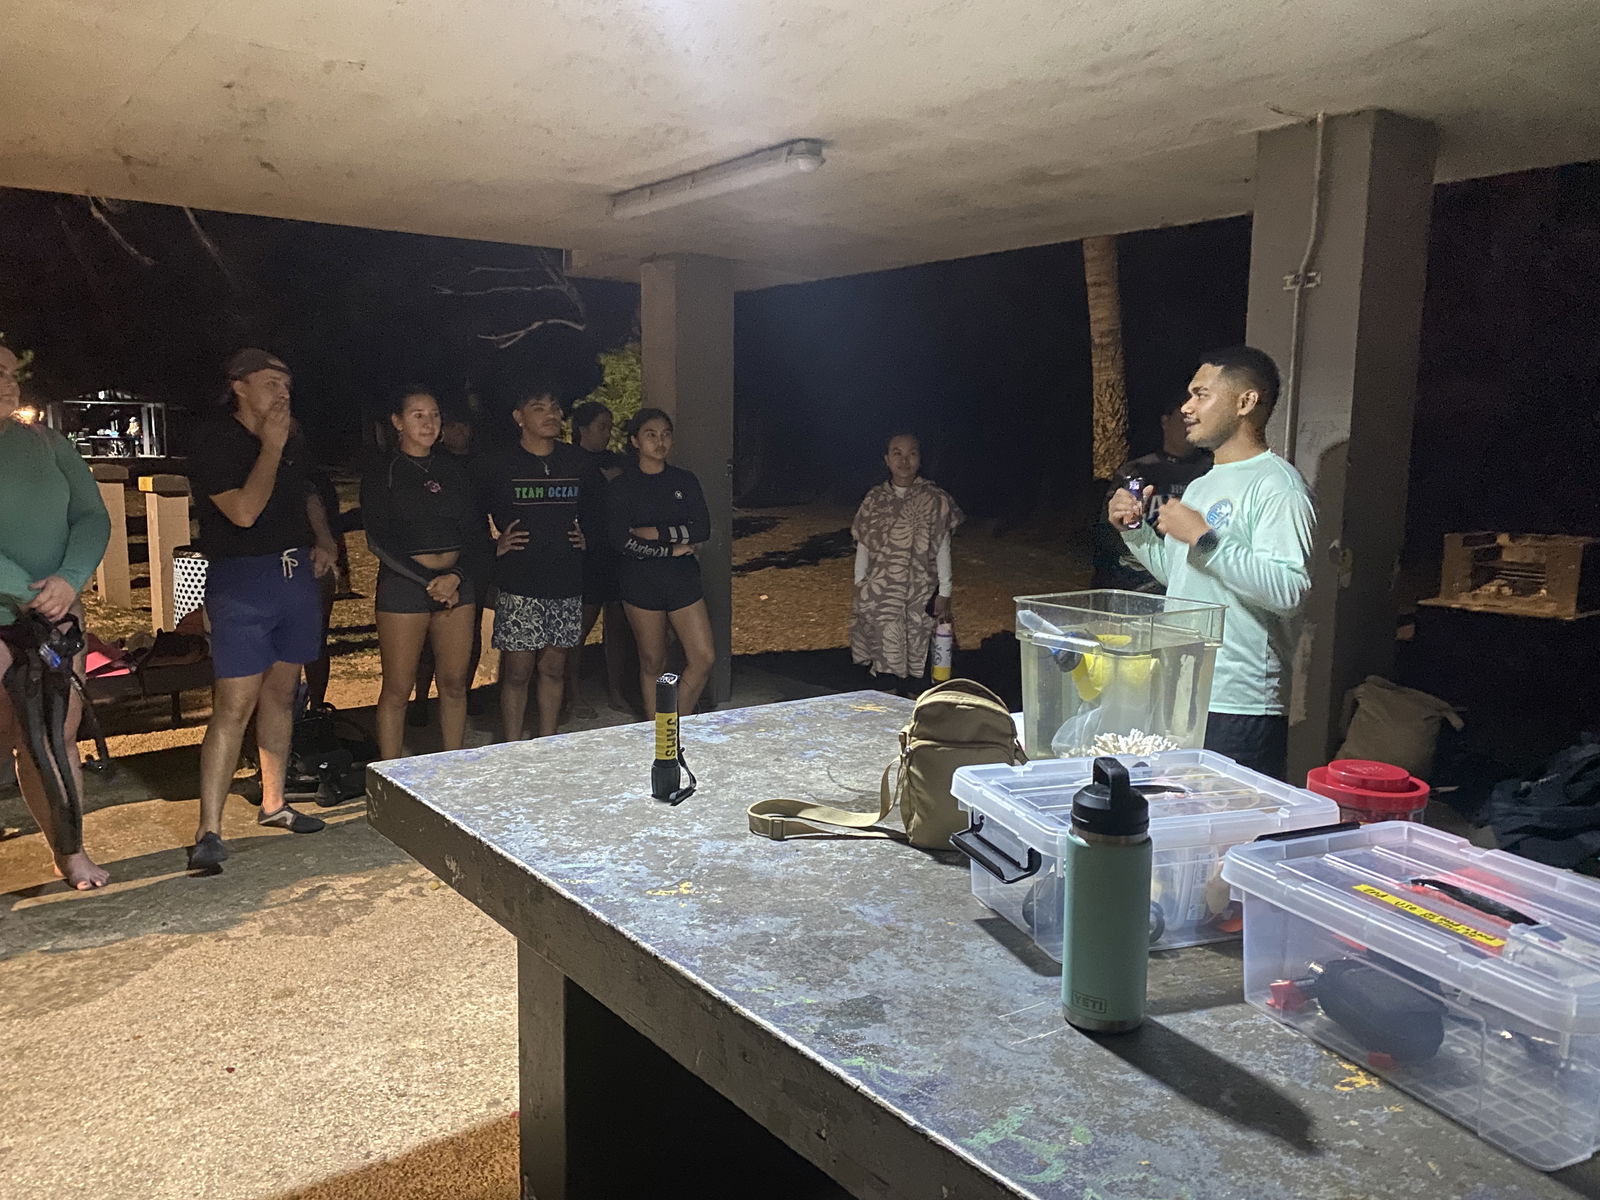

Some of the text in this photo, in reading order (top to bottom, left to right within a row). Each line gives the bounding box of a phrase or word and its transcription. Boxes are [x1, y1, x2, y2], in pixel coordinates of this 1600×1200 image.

[514, 487, 544, 499] TEAM
[624, 538, 660, 557] Hurley
[666, 718, 677, 757] JAMS
[1073, 993, 1104, 1011] YETI
